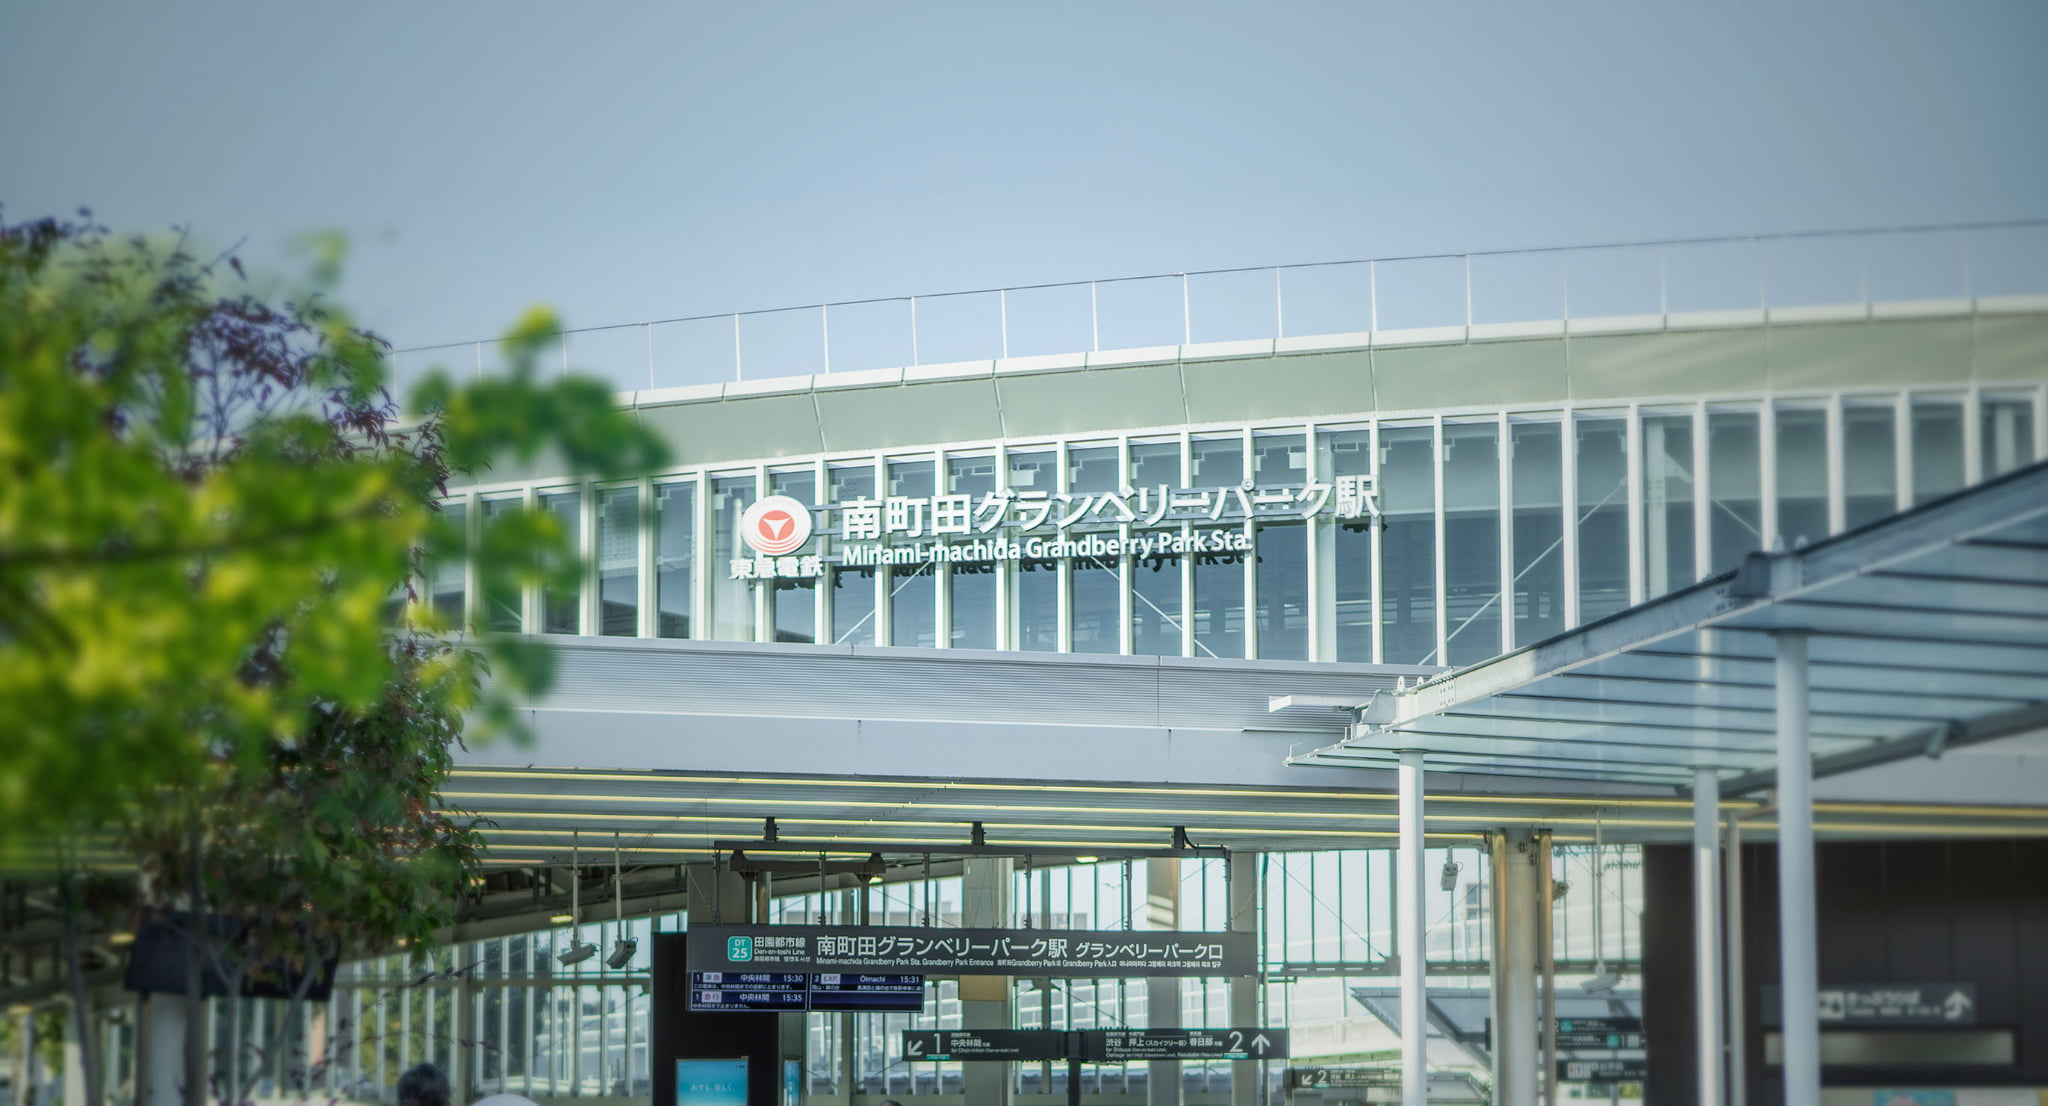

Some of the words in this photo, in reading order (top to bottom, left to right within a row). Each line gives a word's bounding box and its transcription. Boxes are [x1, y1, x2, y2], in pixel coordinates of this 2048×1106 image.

[841, 473, 1381, 541] 南町田グランベリーパーク駅
[842, 542, 1021, 567] Minami-machida
[1025, 532, 1154, 561] Grandberry
[1157, 528, 1206, 554] Park
[1212, 528, 1253, 551] Sta.
[729, 556, 824, 580] 東急電鉄
[754, 936, 806, 948] 田園都市線
[816, 935, 1068, 959] 南町田グランベリーパーク駅
[1075, 941, 1224, 960] グランベリーパーク口
[732, 948, 748, 958] 25
[816, 957, 862, 965] Minami-machida
[863, 957, 895, 966] Grandberry
[910, 958, 921, 966] Sta.
[923, 958, 954, 967] Grandberry
[1063, 960, 1093, 968] Grandberry
[740, 974, 771, 982] 中央林間
[739, 993, 769, 1002] 中央林間
[934, 1033, 940, 1053] 1
[951, 1039, 982, 1047] 中央林間
[1105, 1038, 1122, 1047] 渋谷
[1189, 1038, 1213, 1046] 春日部
[1229, 1031, 1243, 1052] 2
[1318, 1070, 1327, 1084] 2
